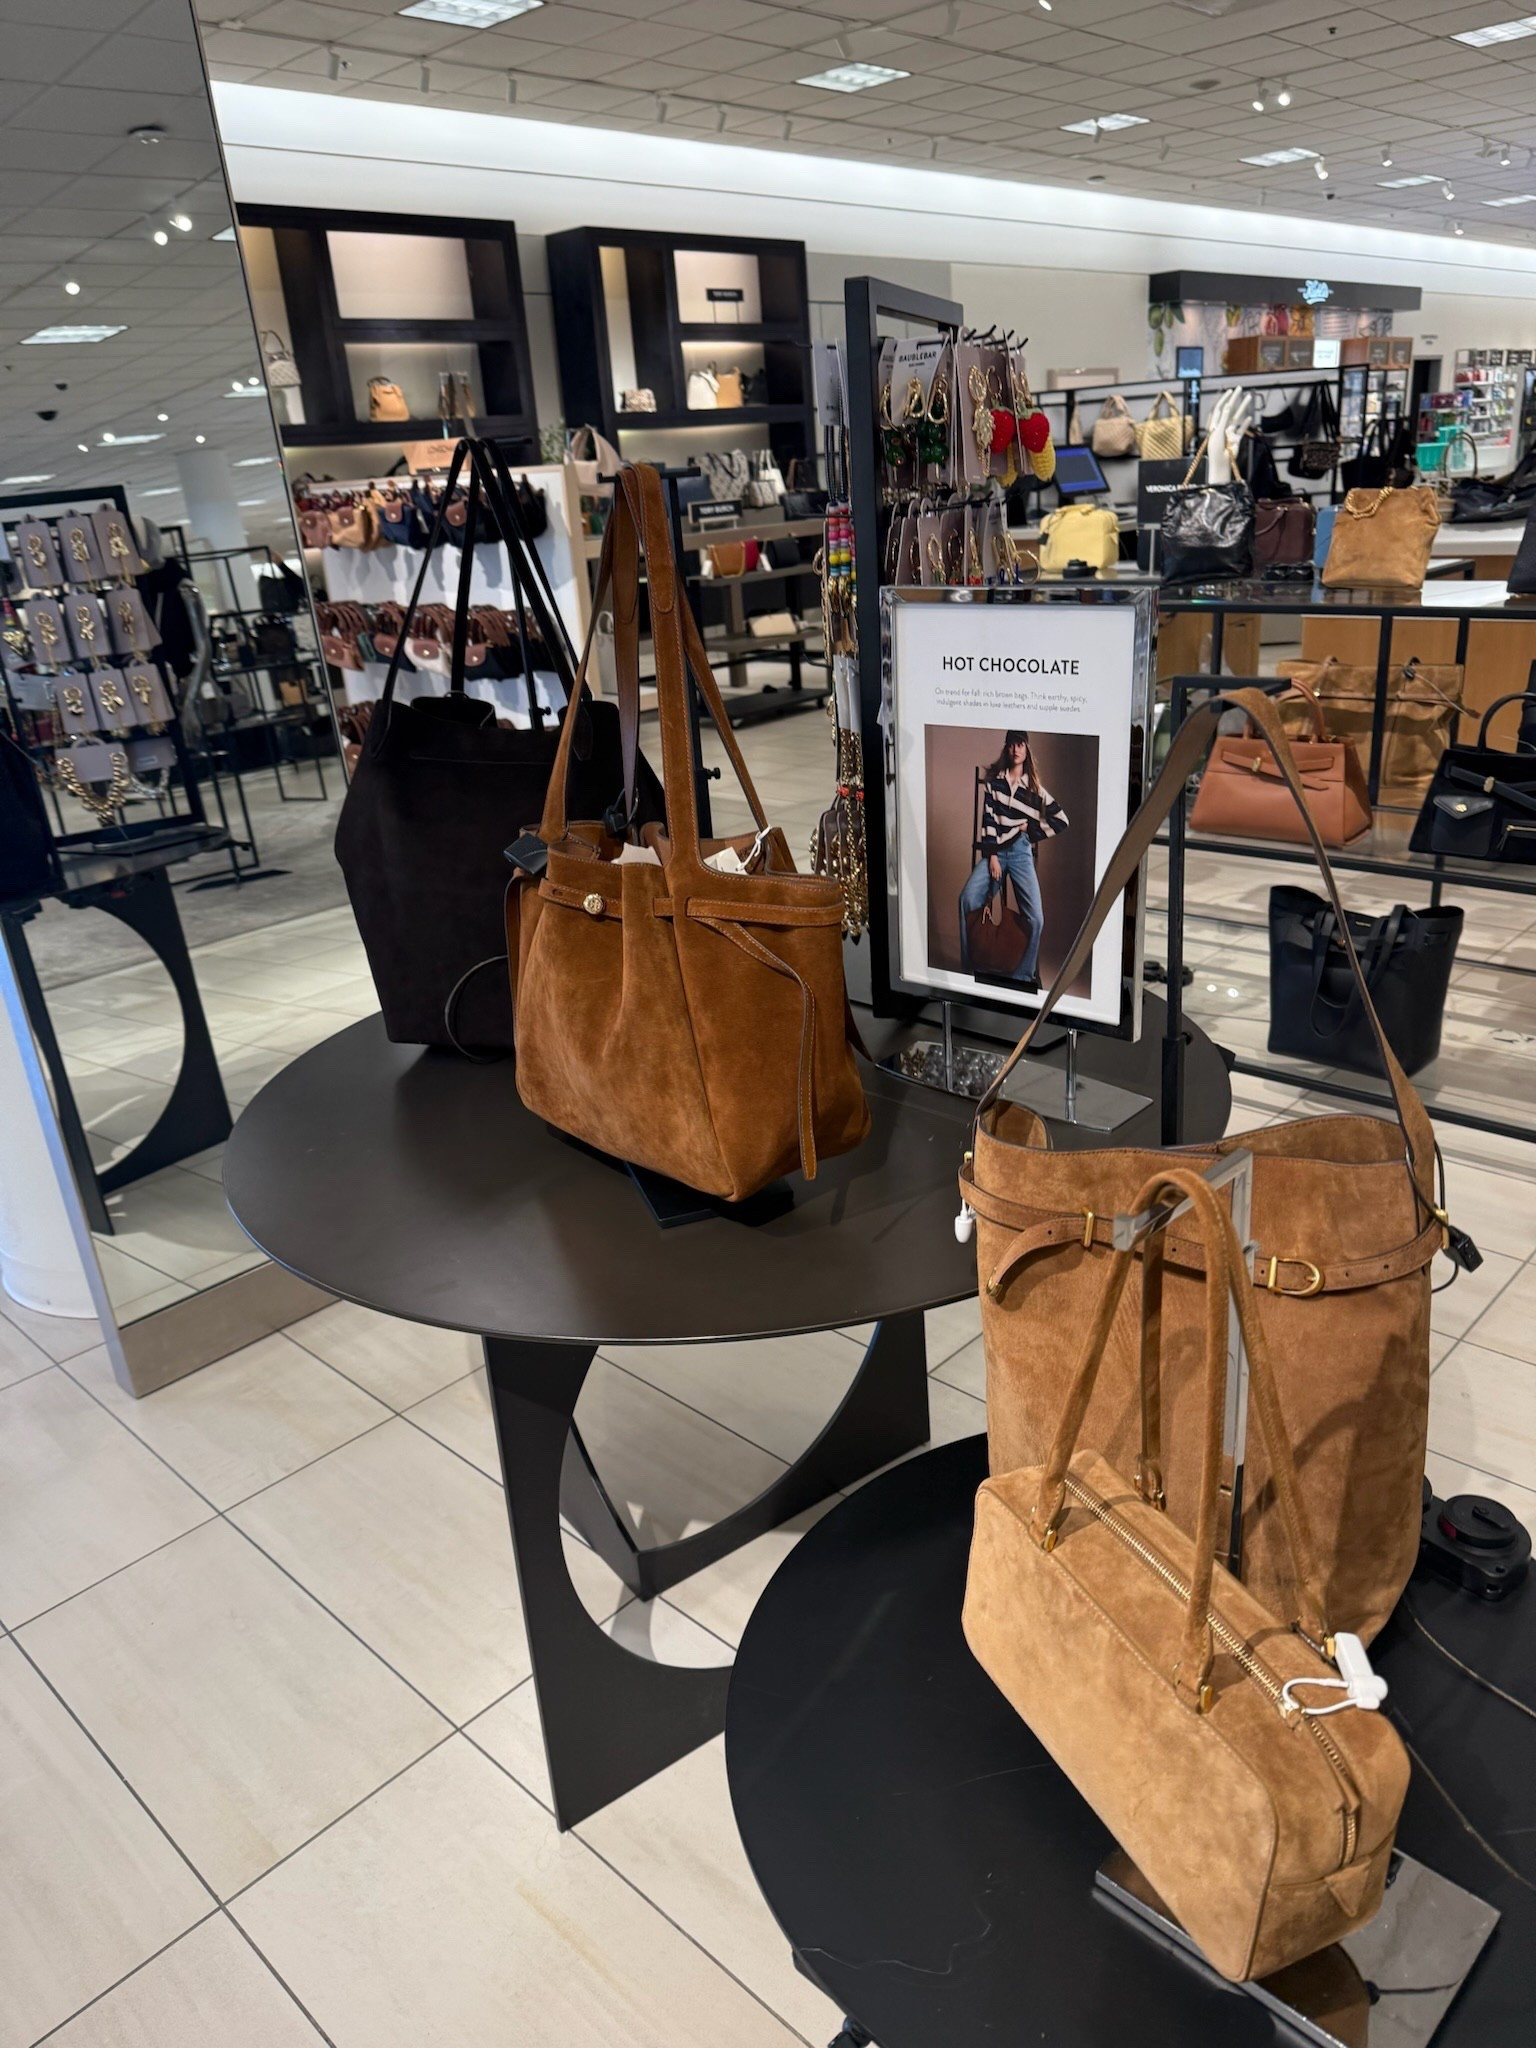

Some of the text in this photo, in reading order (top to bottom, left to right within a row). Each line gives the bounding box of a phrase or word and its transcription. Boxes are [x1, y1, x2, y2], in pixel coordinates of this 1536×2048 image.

[898, 351, 937, 363] BAUBLEBAR
[1145, 484, 1177, 494] VERONICA
[943, 656, 1080, 676] HOT CHOCOLATE
[934, 687, 945, 695] On
[945, 689, 961, 697] trend
[961, 688, 970, 697] for
[995, 690, 1013, 698] brown
[1030, 692, 1046, 700] Think
[963, 699, 982, 707] shades
[1027, 703, 1038, 711] and
